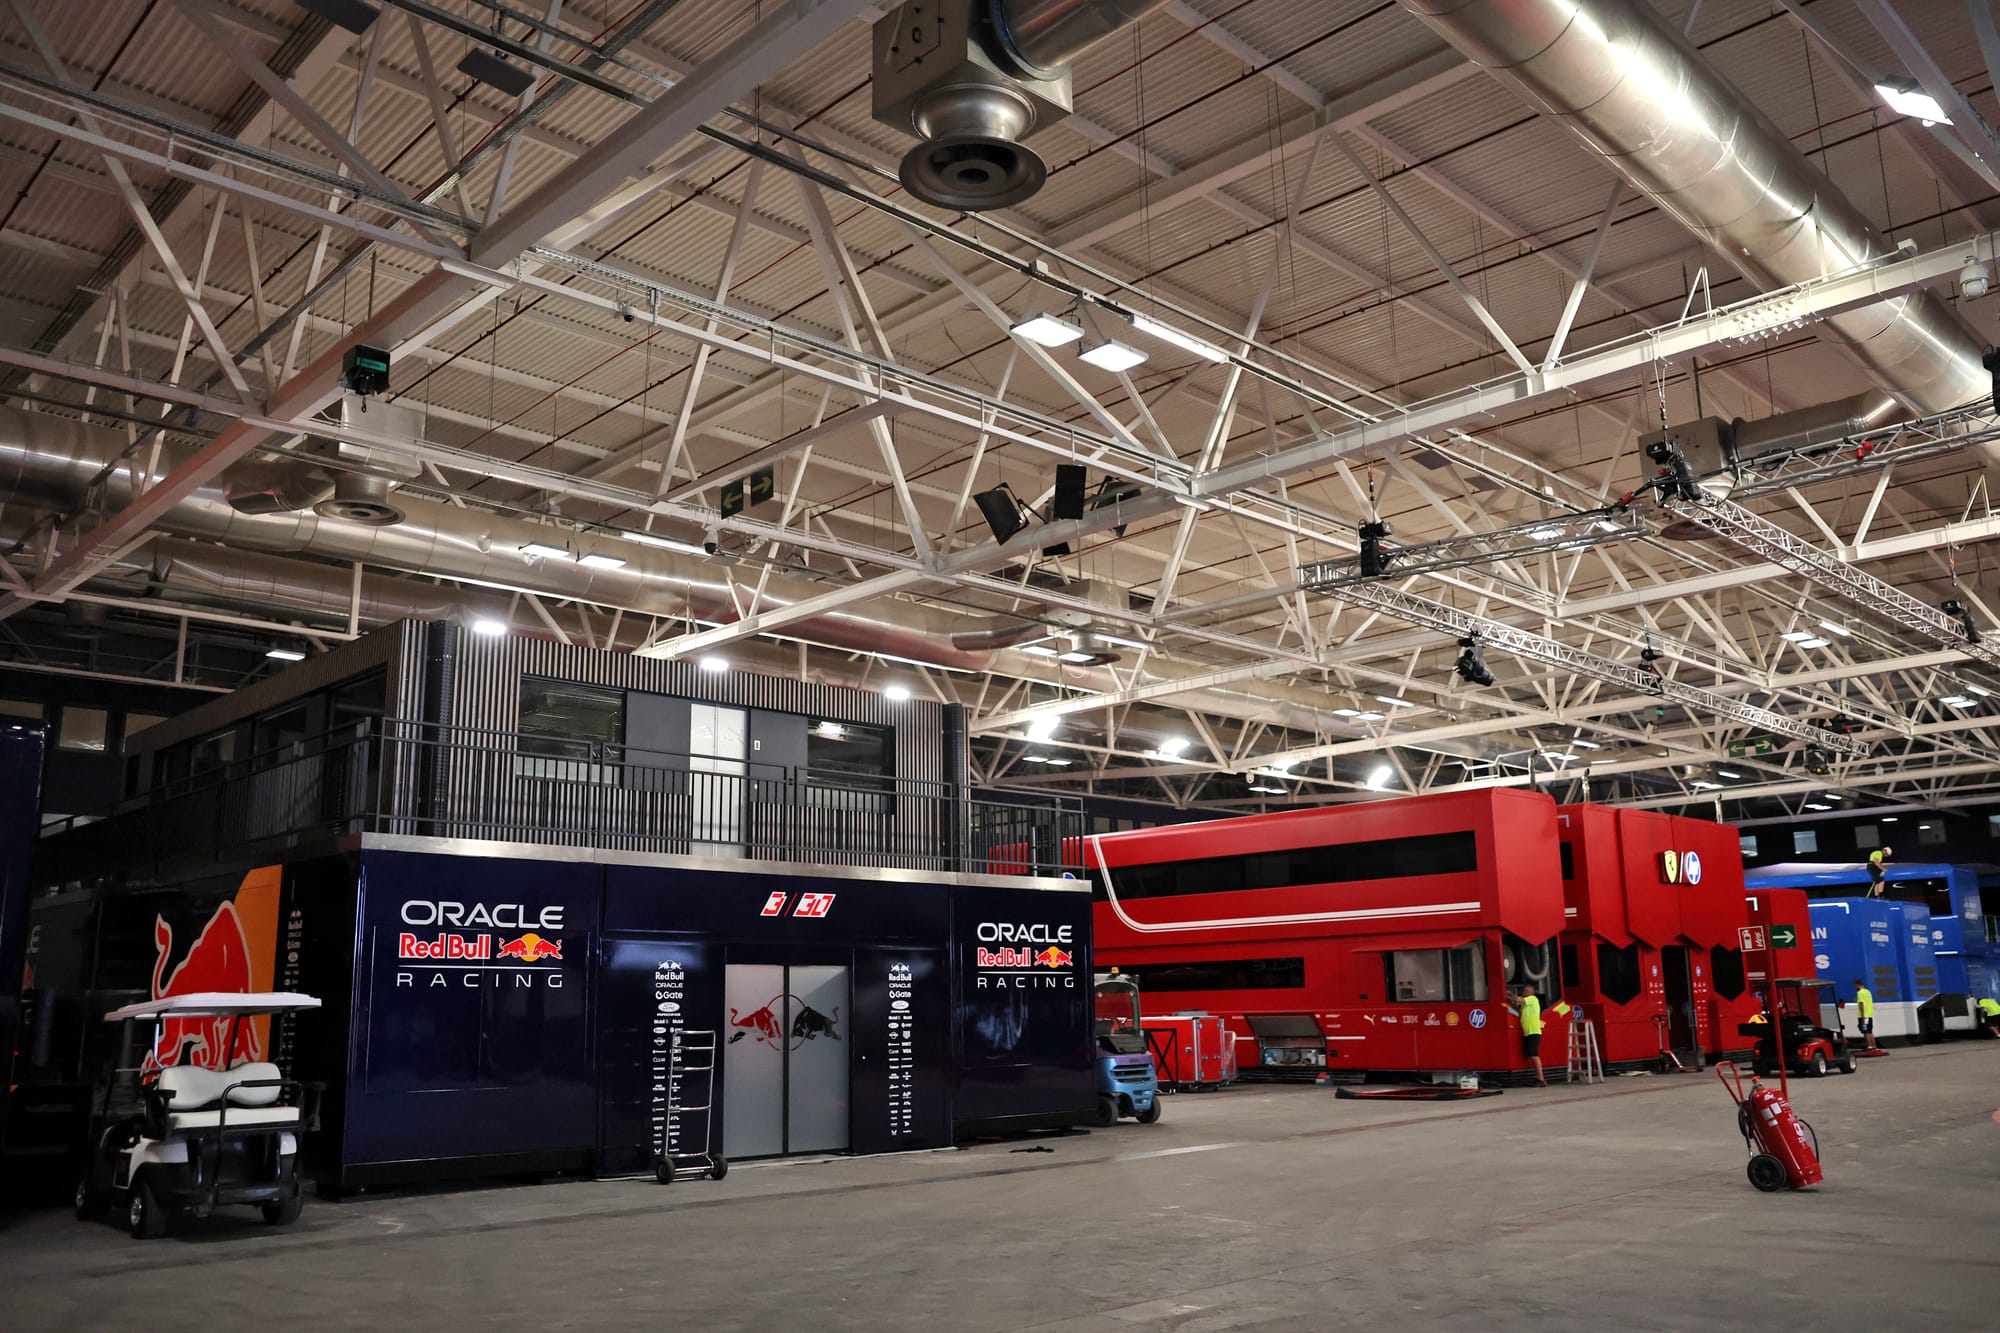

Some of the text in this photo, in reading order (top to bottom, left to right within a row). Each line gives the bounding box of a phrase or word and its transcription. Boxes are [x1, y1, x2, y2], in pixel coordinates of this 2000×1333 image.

[401, 900, 564, 929] ORACLE
[977, 922, 1072, 943] ORACLE
[397, 973, 563, 988] RACING
[977, 977, 1074, 989] RACING
